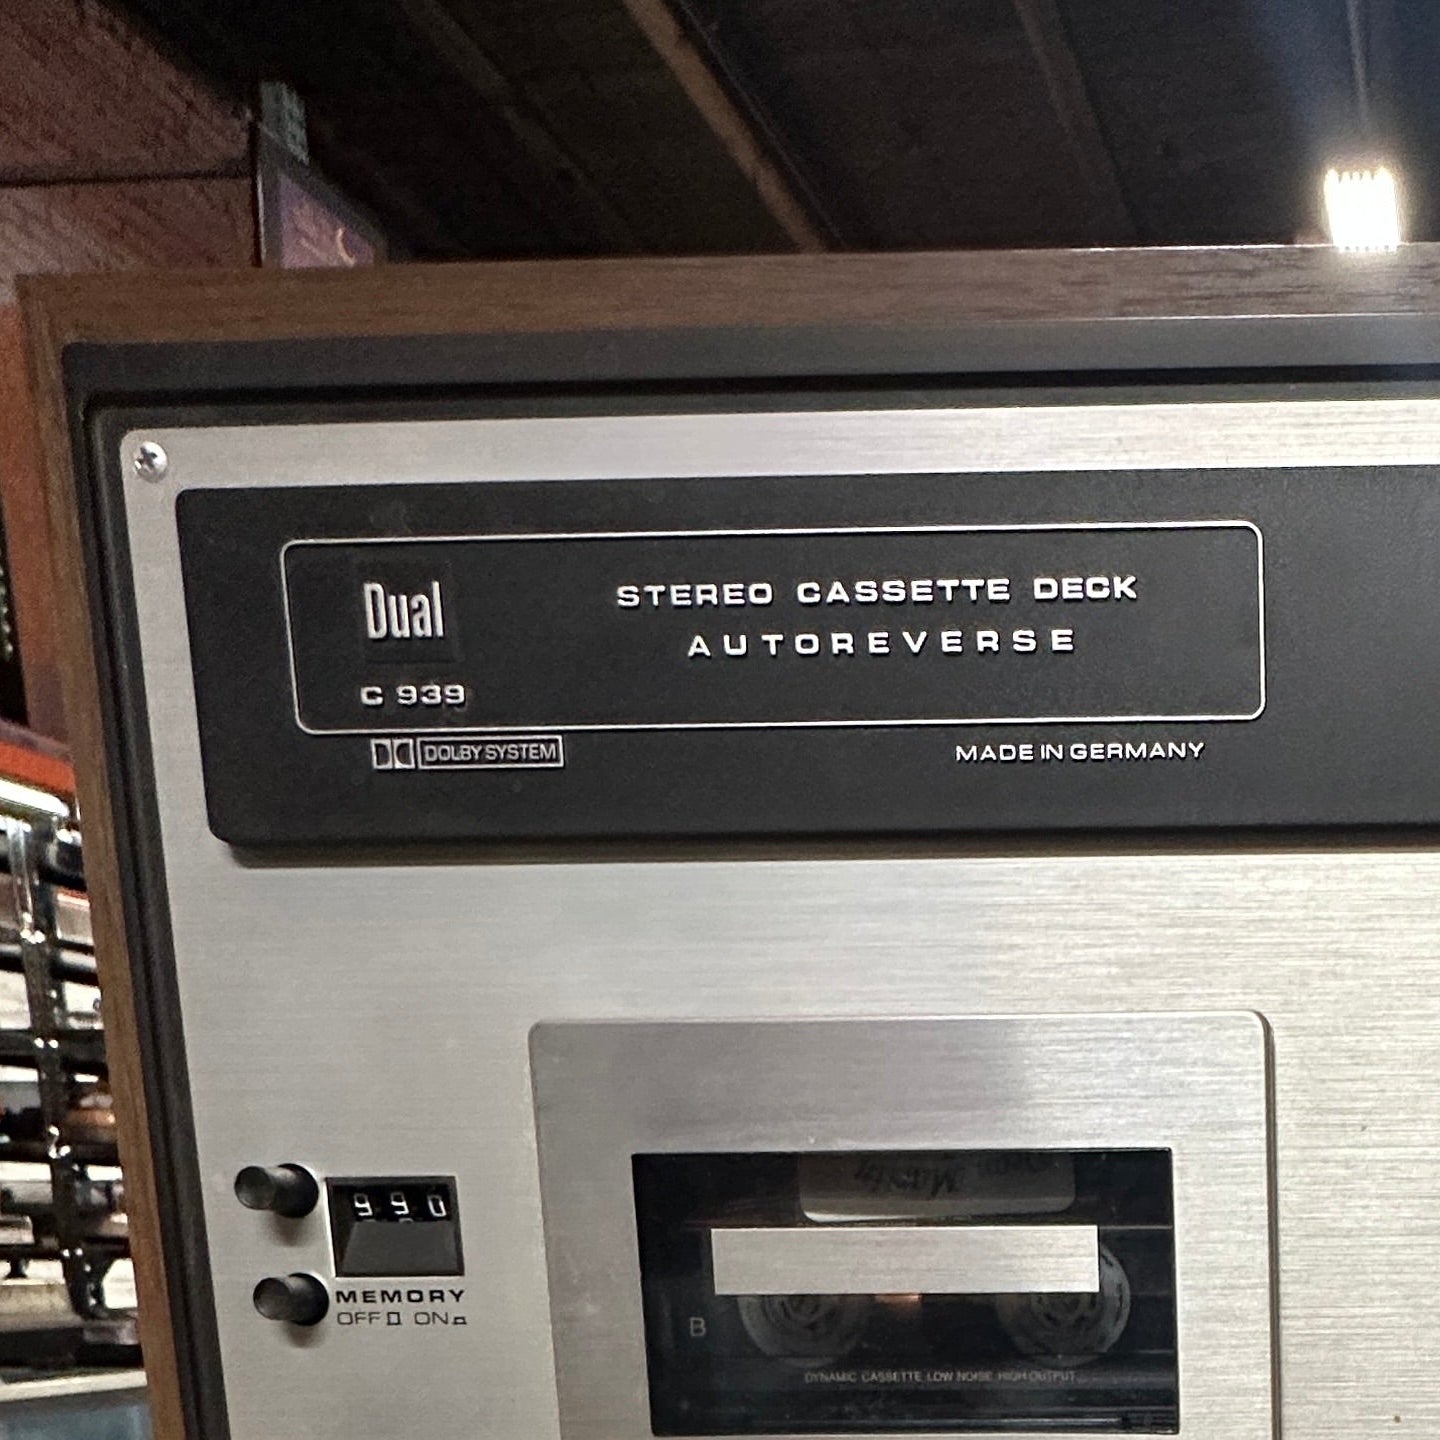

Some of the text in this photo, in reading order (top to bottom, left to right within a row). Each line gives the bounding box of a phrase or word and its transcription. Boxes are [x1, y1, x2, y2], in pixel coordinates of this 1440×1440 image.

[617, 576, 1136, 606] STEREO CASSETTE DECK
[364, 581, 443, 638] Dual
[688, 629, 1073, 656] AUTOREVERSE
[361, 685, 464, 704] C 939
[425, 743, 557, 762] DOLBY SYSTEM
[956, 742, 1203, 760] MADE IN GERMANY
[336, 1290, 464, 1303] MEMORY
[337, 1312, 448, 1325] OFF ON
[690, 1317, 706, 1337] B
[804, 1370, 1076, 1384] DYNAMIC CASSETTE LOW NOISE HIGH OUTPUT
